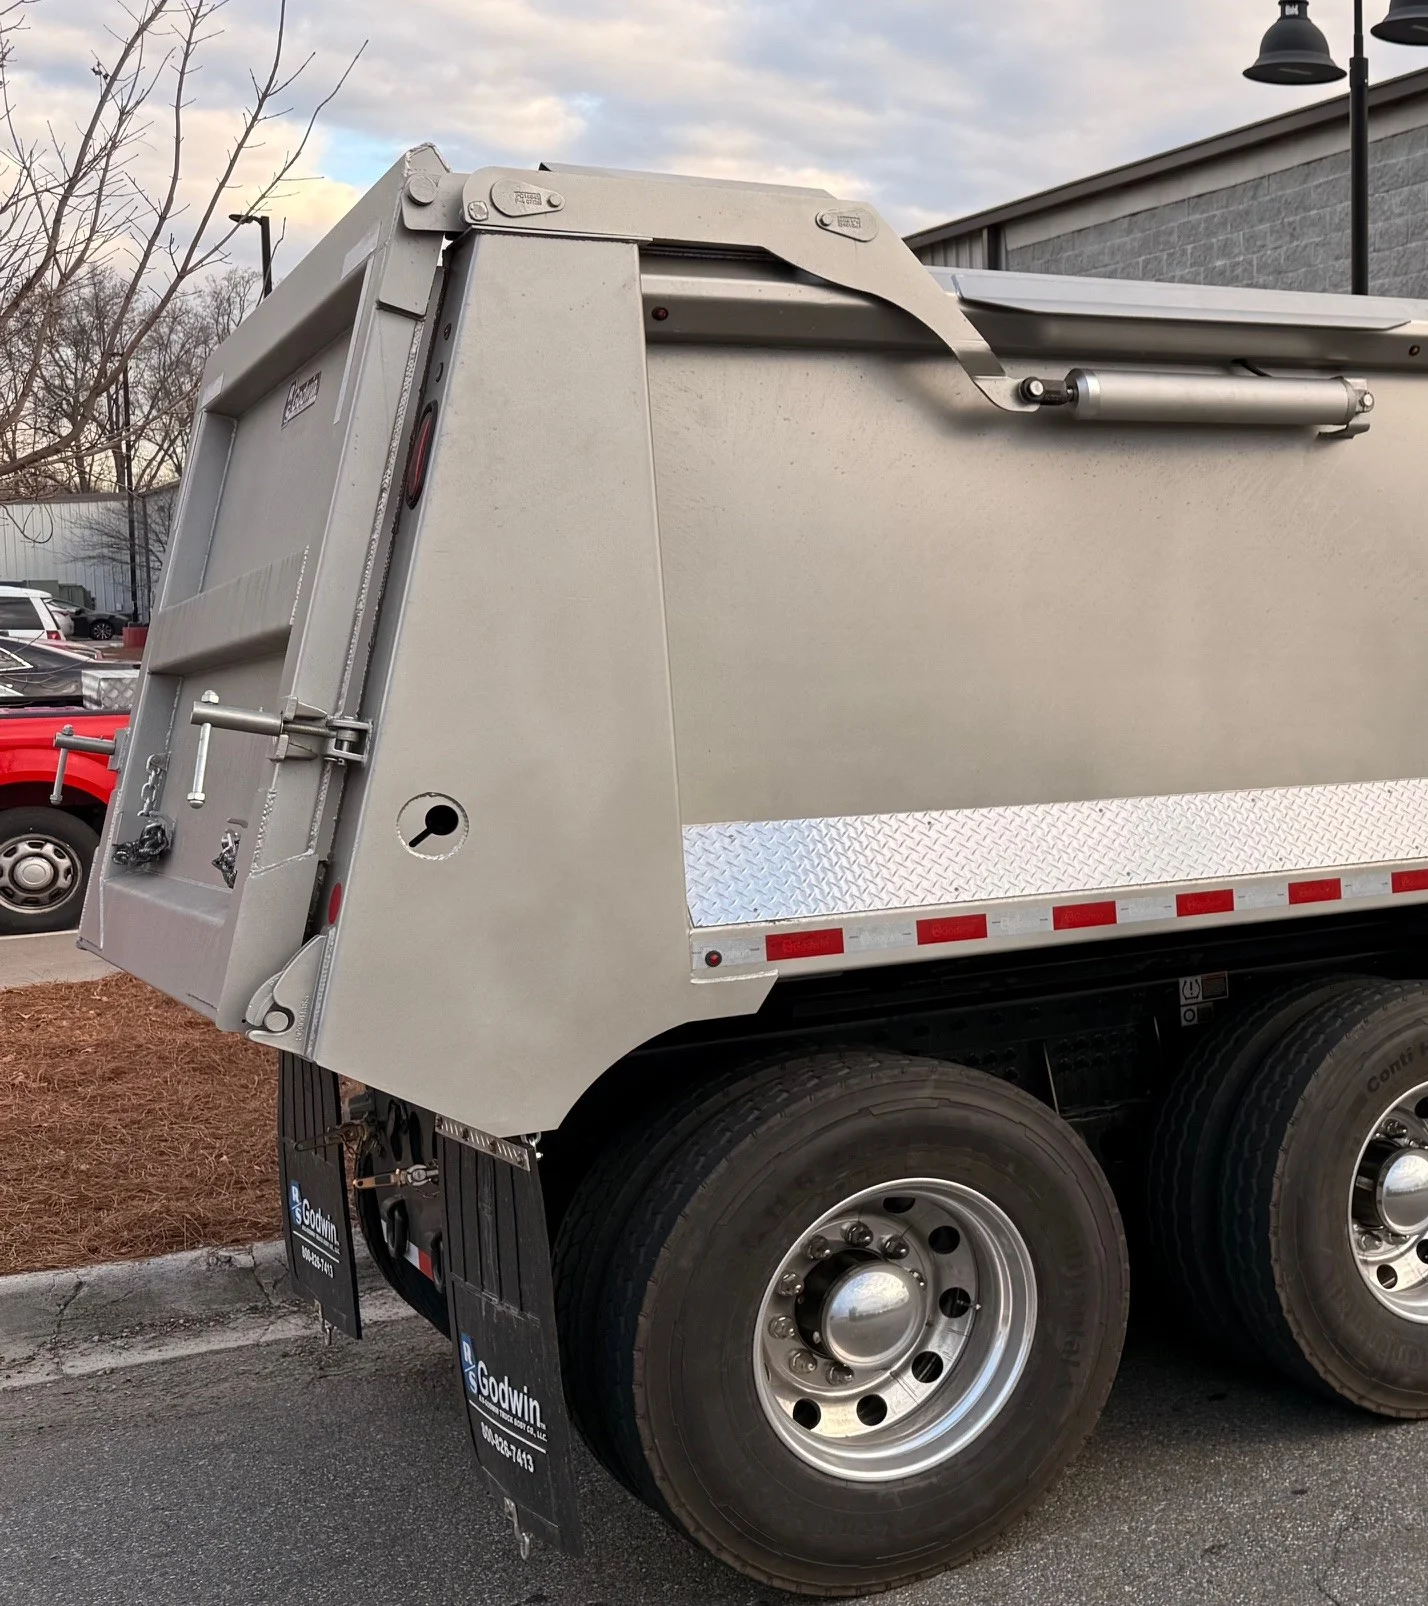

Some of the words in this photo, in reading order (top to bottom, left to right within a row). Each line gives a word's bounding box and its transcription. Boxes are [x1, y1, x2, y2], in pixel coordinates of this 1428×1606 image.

[1367, 1046, 1415, 1094] Conti
[302, 1198, 338, 1243] Godwin
[477, 1360, 541, 1428] Godwin
[480, 1421, 535, 1474] 800-826-7413
